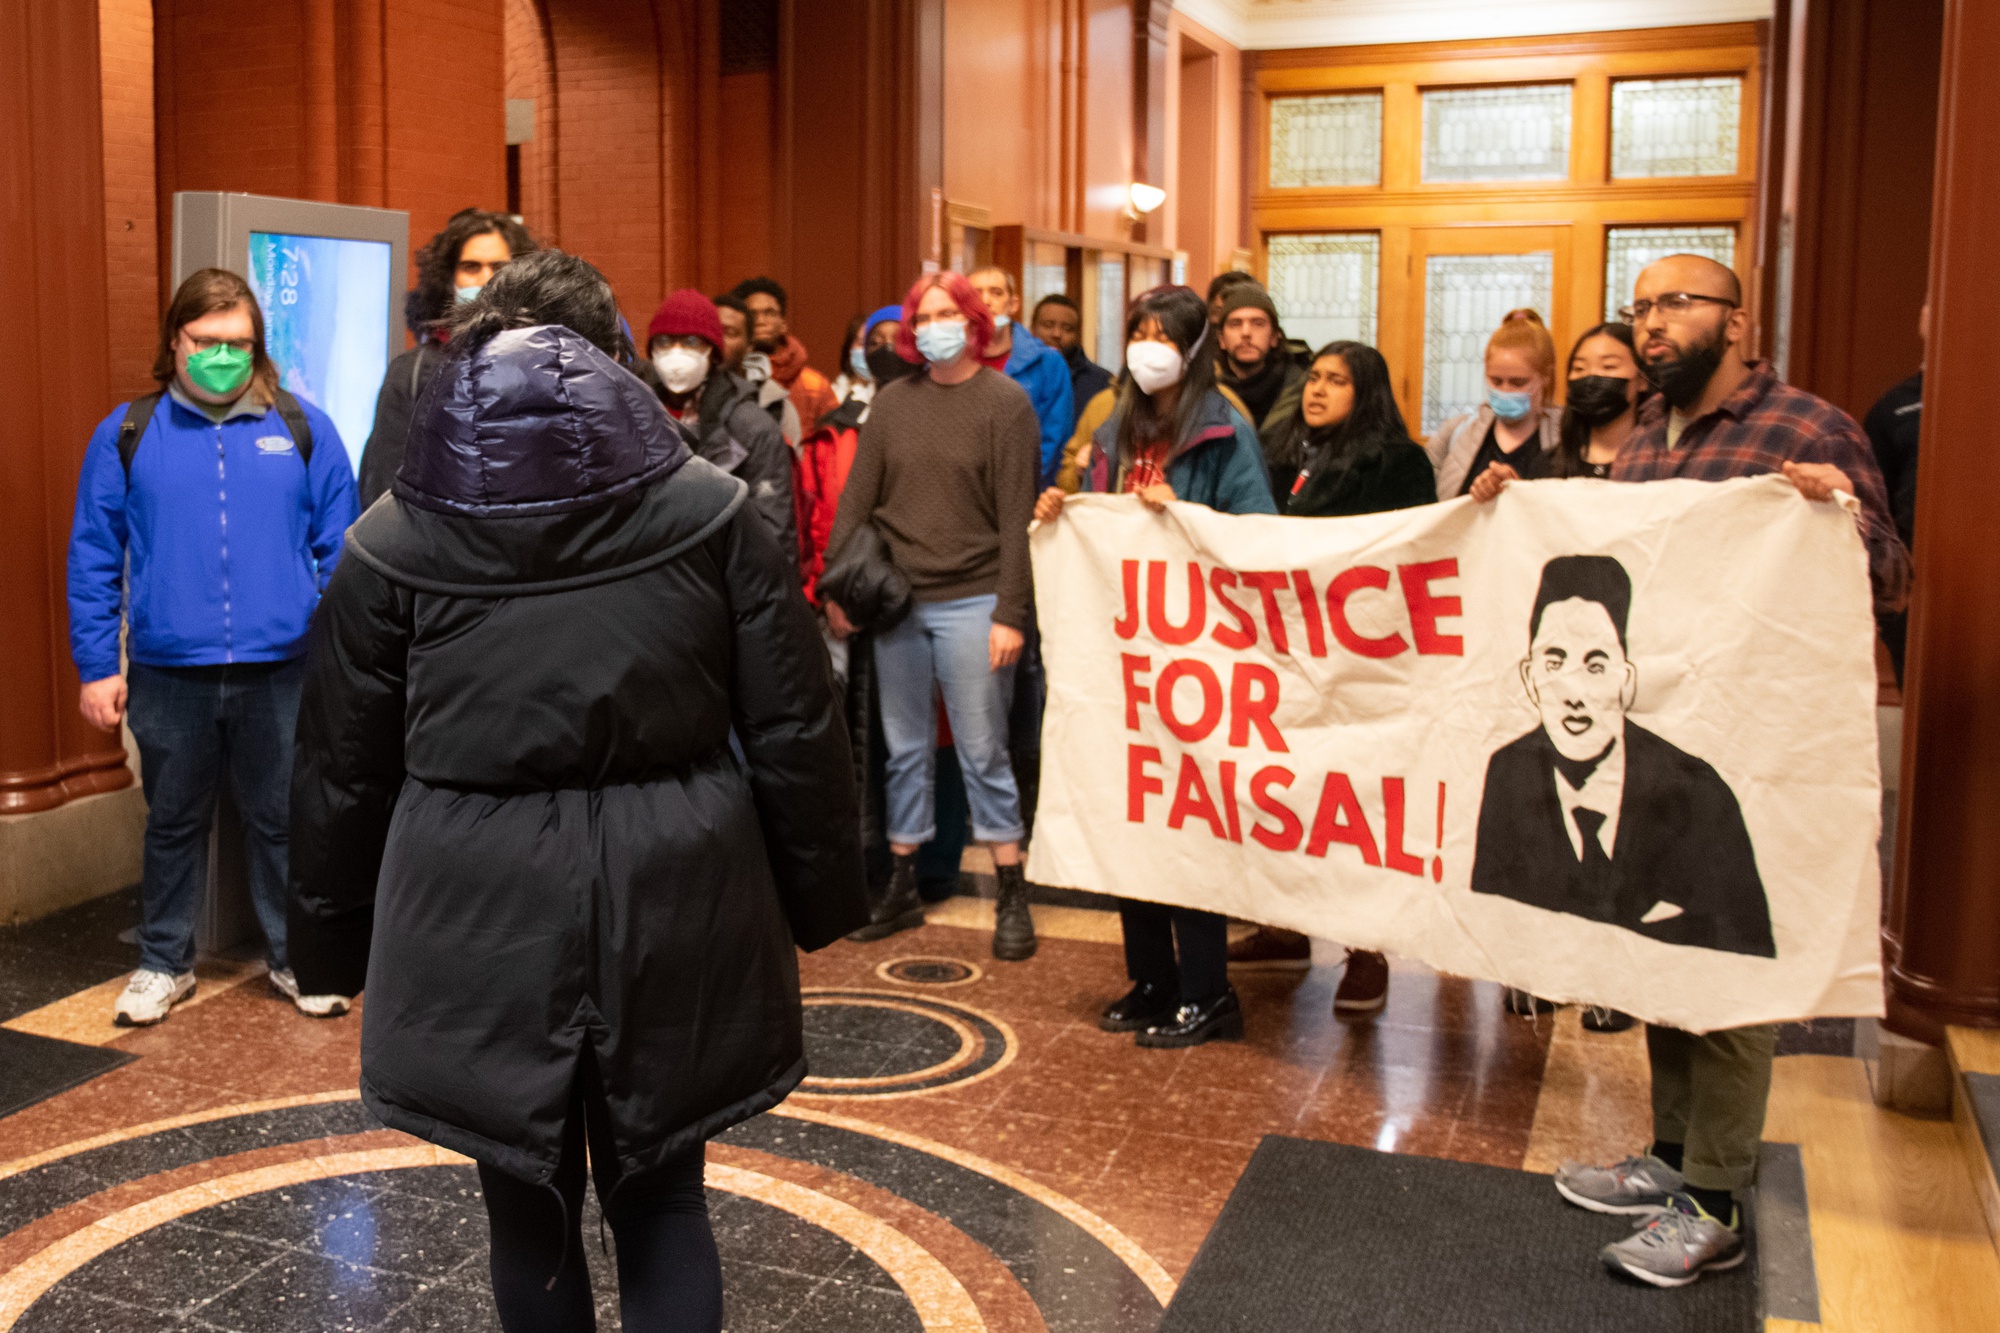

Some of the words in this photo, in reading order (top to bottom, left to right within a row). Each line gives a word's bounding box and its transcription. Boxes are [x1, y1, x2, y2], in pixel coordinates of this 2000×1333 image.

[281, 245, 299, 305] 7:28
[265, 310, 275, 354] Januar
[1114, 557, 1464, 660] JUSTICE
[1122, 653, 1289, 753] FOR
[1126, 744, 1447, 884] FAISAL!
